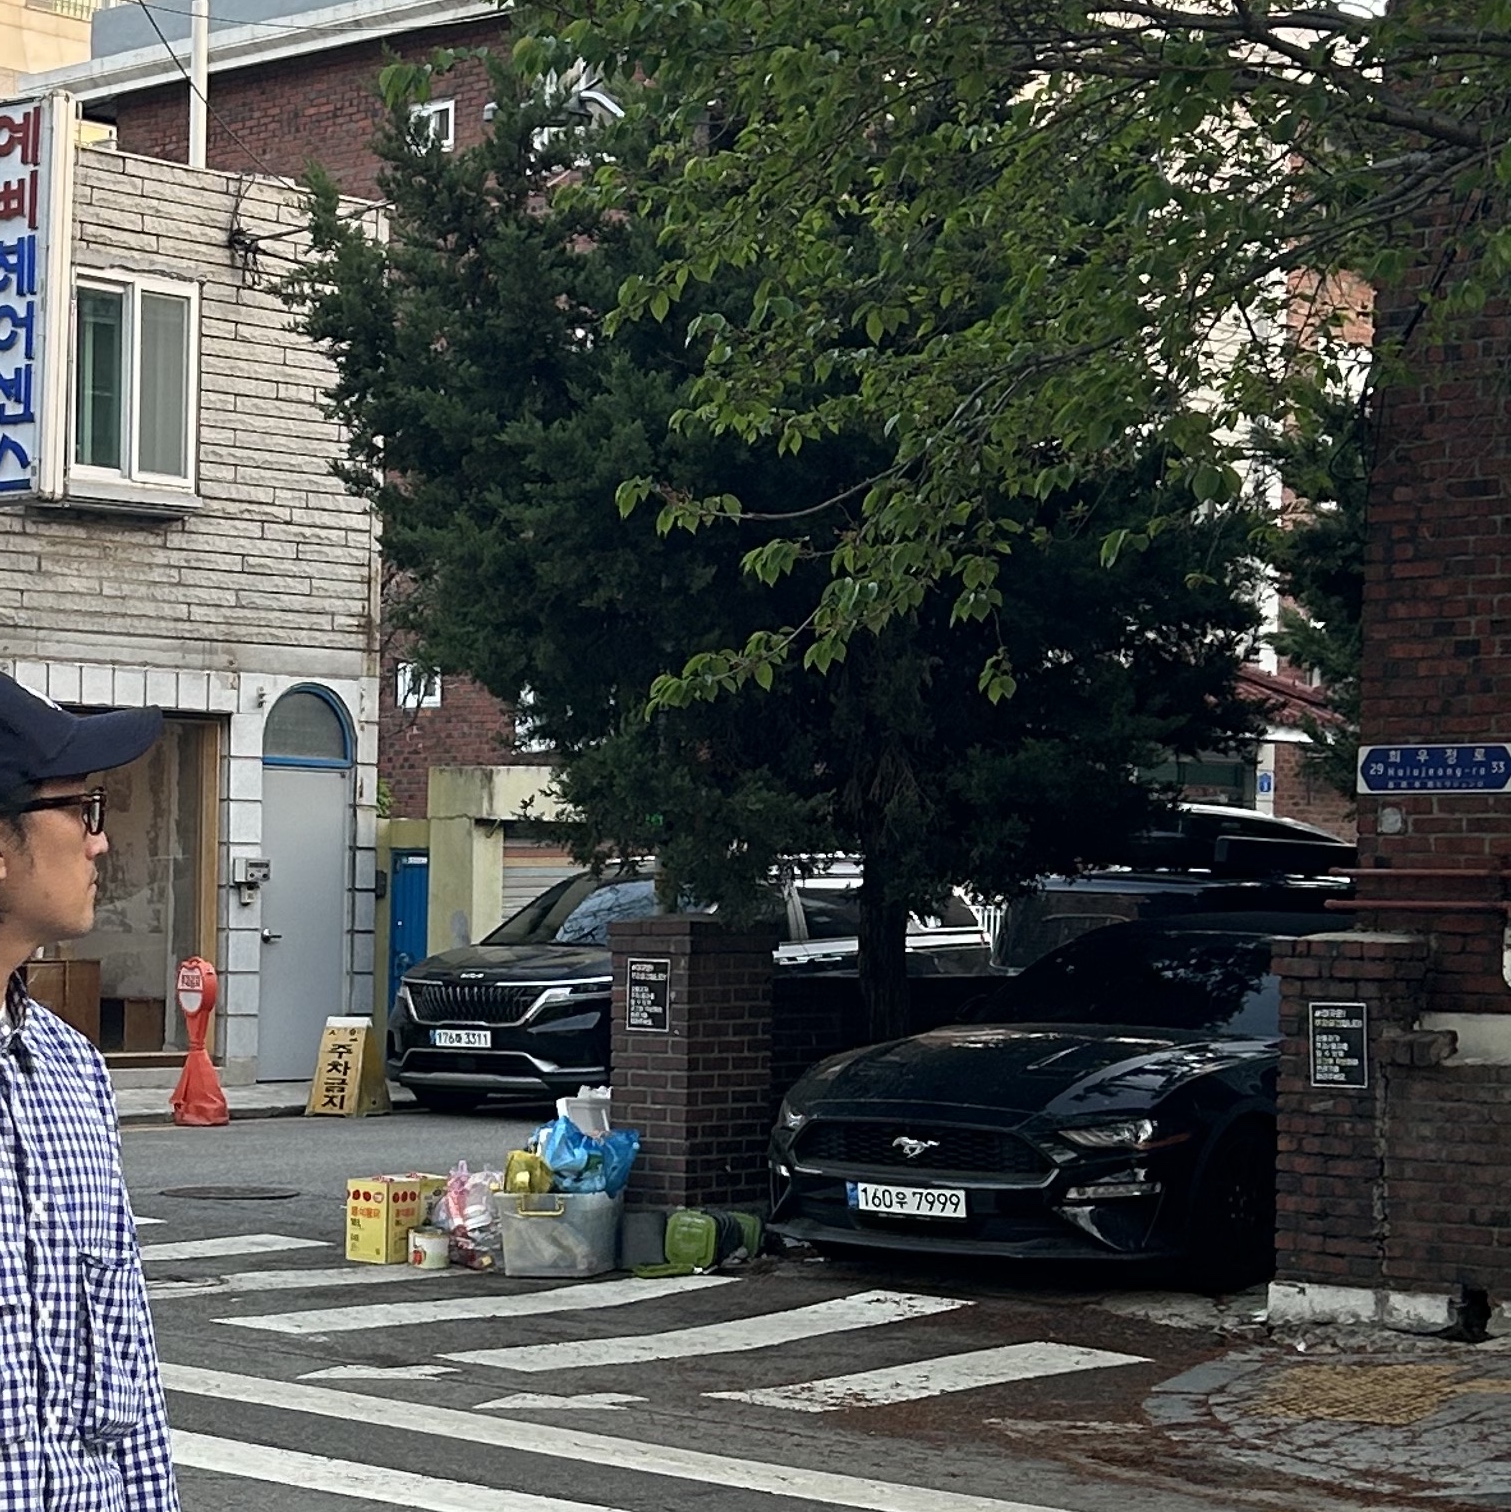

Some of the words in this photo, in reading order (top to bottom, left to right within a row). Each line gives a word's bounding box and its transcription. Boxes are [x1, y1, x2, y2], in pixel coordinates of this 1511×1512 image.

[1388, 748, 1486, 765] 희우정로
[1369, 763, 1384, 775] 29
[1491, 761, 1506, 774] 33
[321, 1043, 353, 1110] 주차금지
[861, 1186, 908, 1209] 160우
[912, 1191, 961, 1213] 7999
